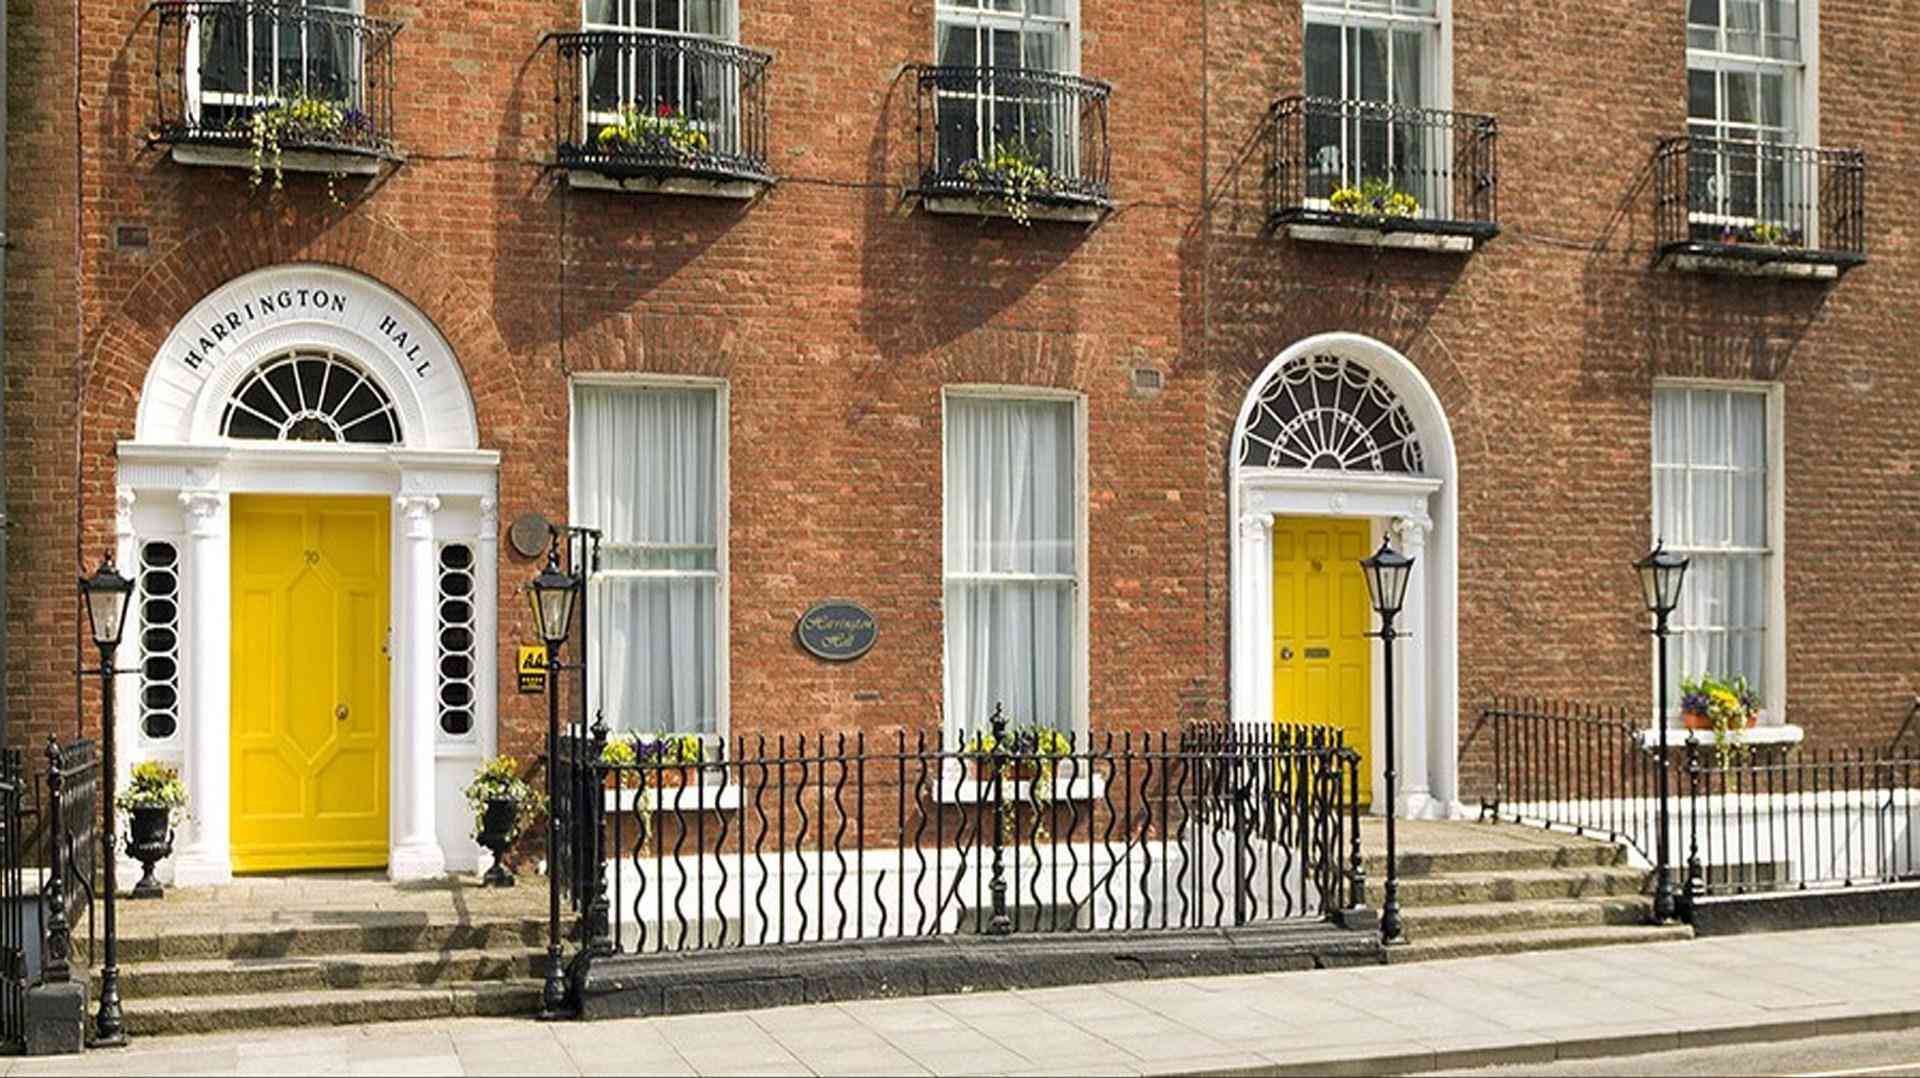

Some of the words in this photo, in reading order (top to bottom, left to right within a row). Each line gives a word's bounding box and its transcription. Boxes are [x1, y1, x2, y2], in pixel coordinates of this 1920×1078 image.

[184, 289, 347, 370] HARRINGTON
[379, 315, 434, 378] HALL
[822, 631, 855, 648] Hall
[522, 652, 544, 668] AA
